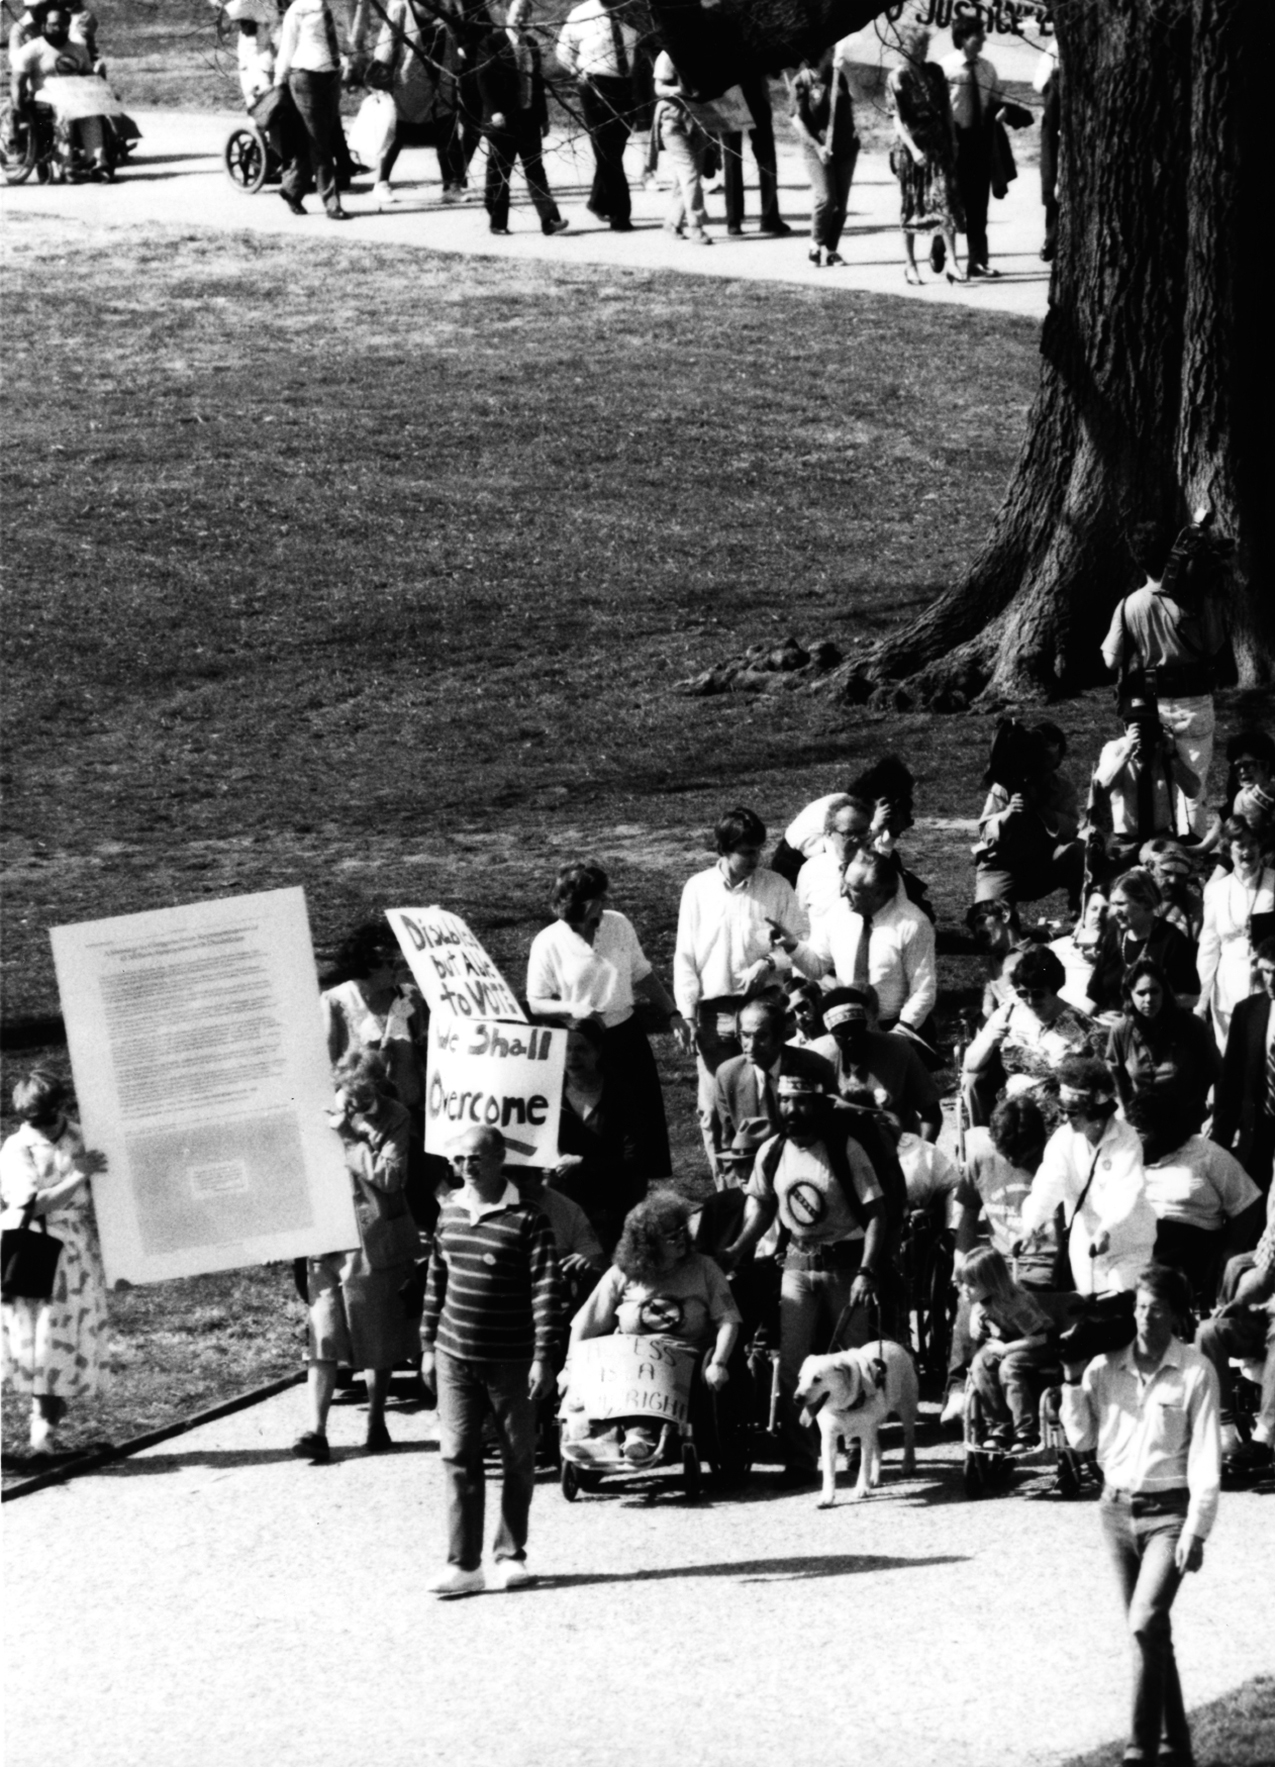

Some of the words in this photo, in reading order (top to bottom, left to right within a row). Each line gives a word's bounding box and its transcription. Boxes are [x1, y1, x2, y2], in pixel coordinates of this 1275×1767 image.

[436, 1018, 460, 1054] We
[467, 1023, 553, 1061] Shall
[428, 1067, 550, 1128] Overcome
[638, 1362, 654, 1380] A
